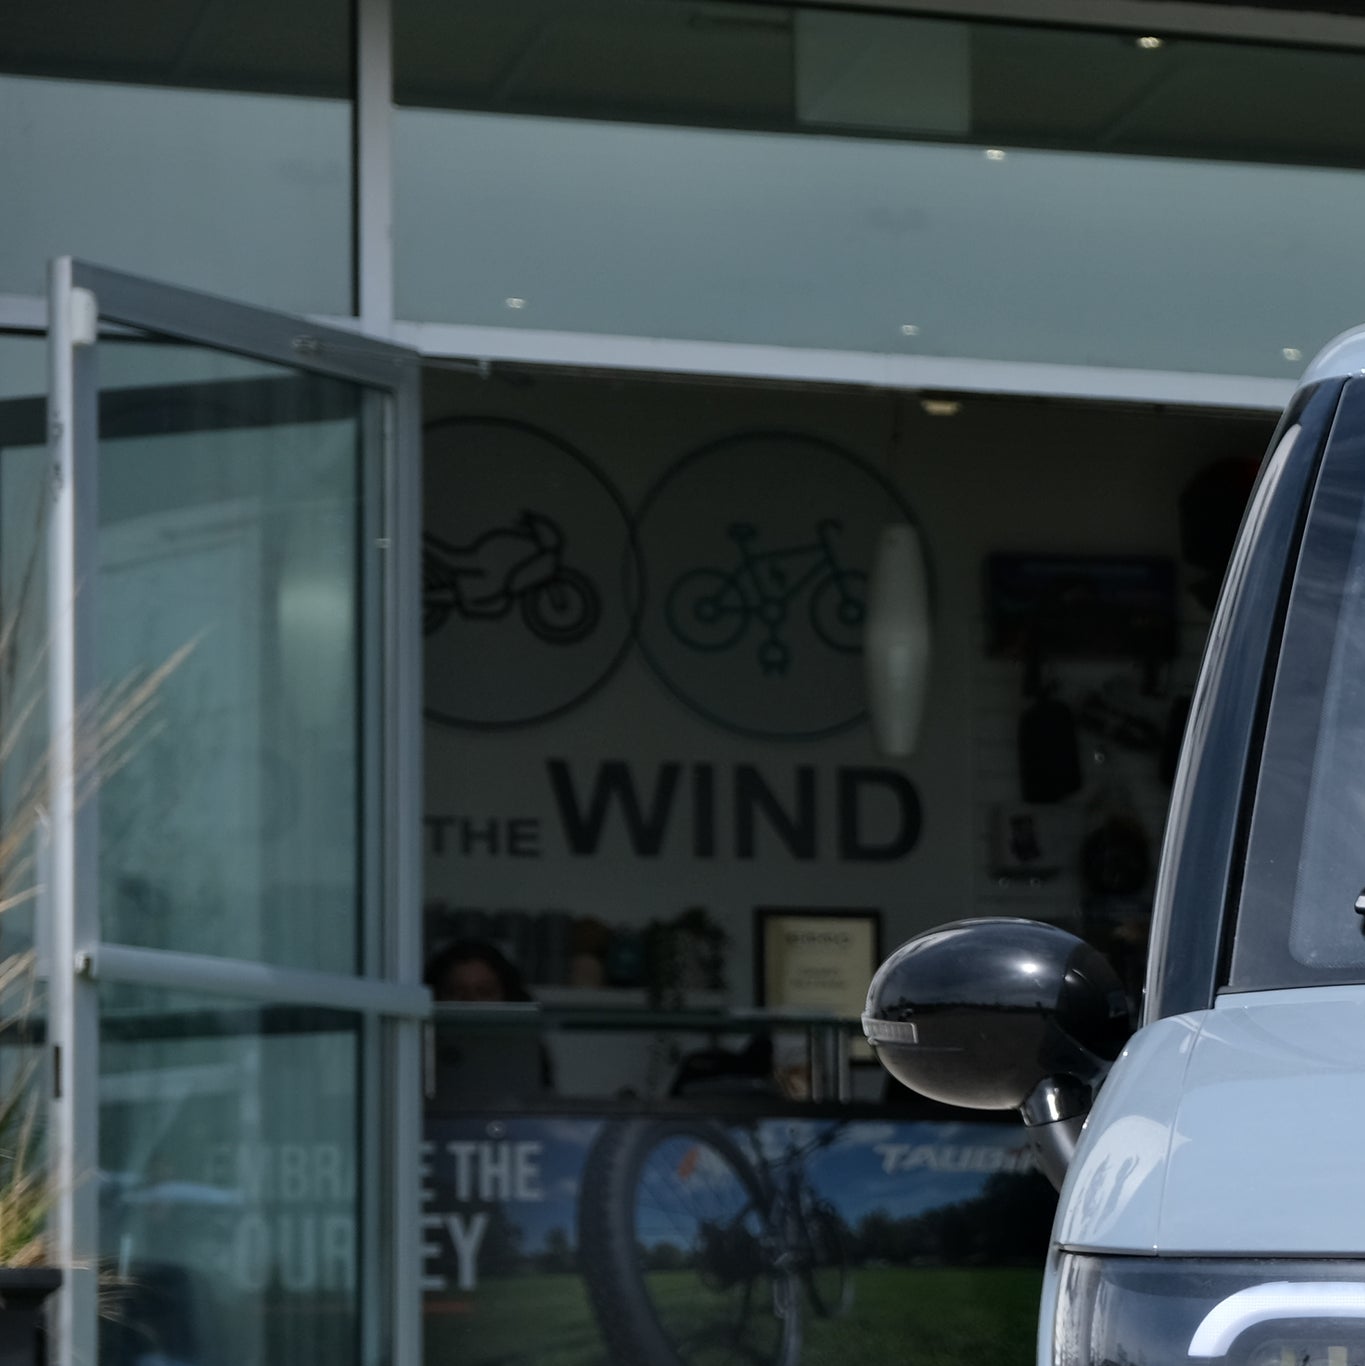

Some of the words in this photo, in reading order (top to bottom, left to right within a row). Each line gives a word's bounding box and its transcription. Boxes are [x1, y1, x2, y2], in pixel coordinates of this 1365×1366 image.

[423, 815, 543, 859] THE
[545, 757, 926, 862] WIND
[446, 1141, 546, 1202] THE
